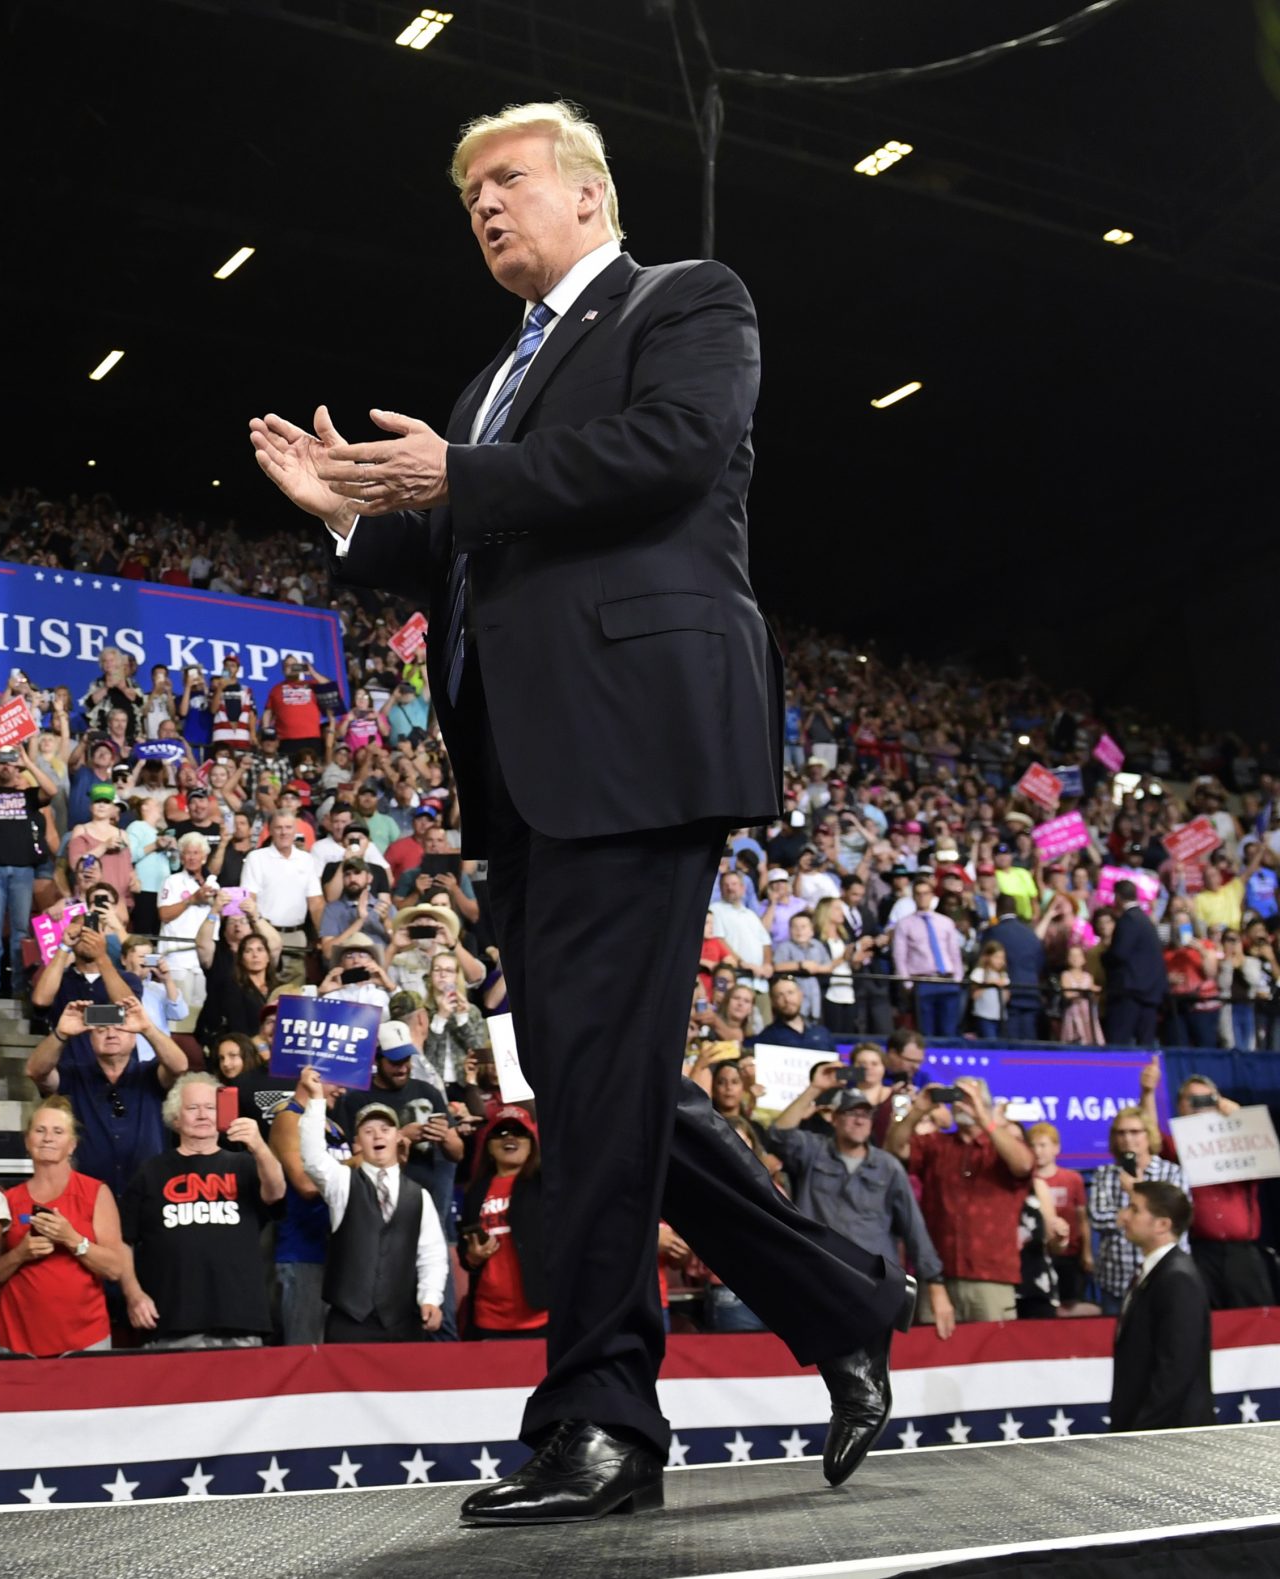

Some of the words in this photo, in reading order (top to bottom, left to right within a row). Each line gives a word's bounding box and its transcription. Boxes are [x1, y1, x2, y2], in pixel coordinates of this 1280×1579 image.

[39, 918, 59, 959] TRU
[280, 1018, 369, 1043] TRUMP
[284, 1035, 358, 1055] PENCE
[1185, 1133, 1277, 1160] AMERICA
[163, 1172, 238, 1203] CNN
[162, 1200, 241, 1228] SUCKS
